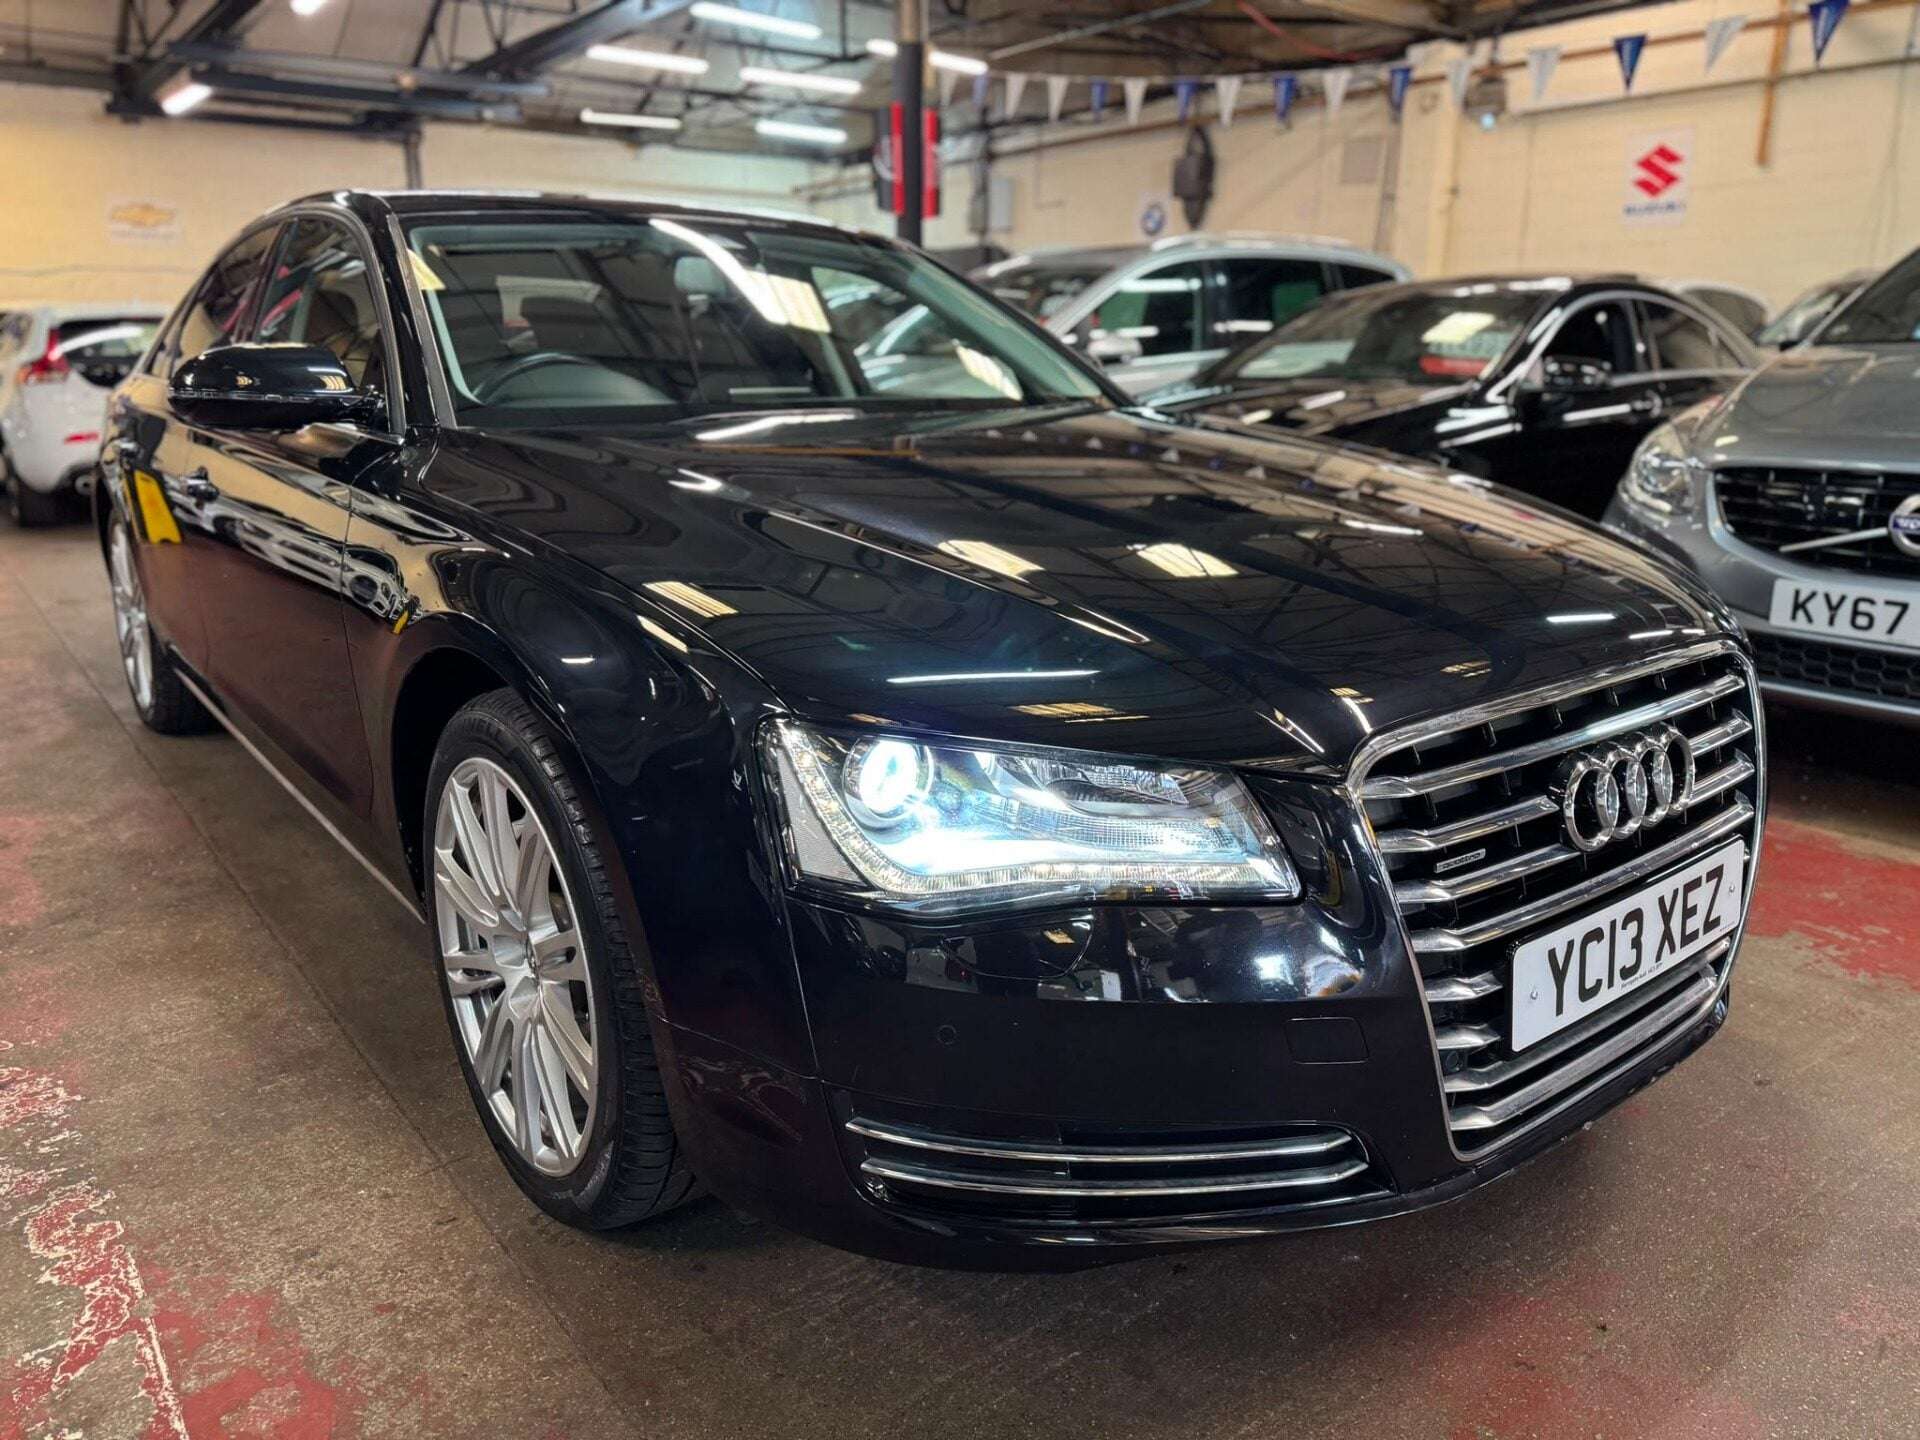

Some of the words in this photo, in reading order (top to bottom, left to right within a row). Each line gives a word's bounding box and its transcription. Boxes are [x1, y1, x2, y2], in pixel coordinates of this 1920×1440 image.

[1790, 588, 1910, 635] KY67
[1547, 906, 1644, 1017] YC13
[1655, 863, 1725, 963] XEZ
